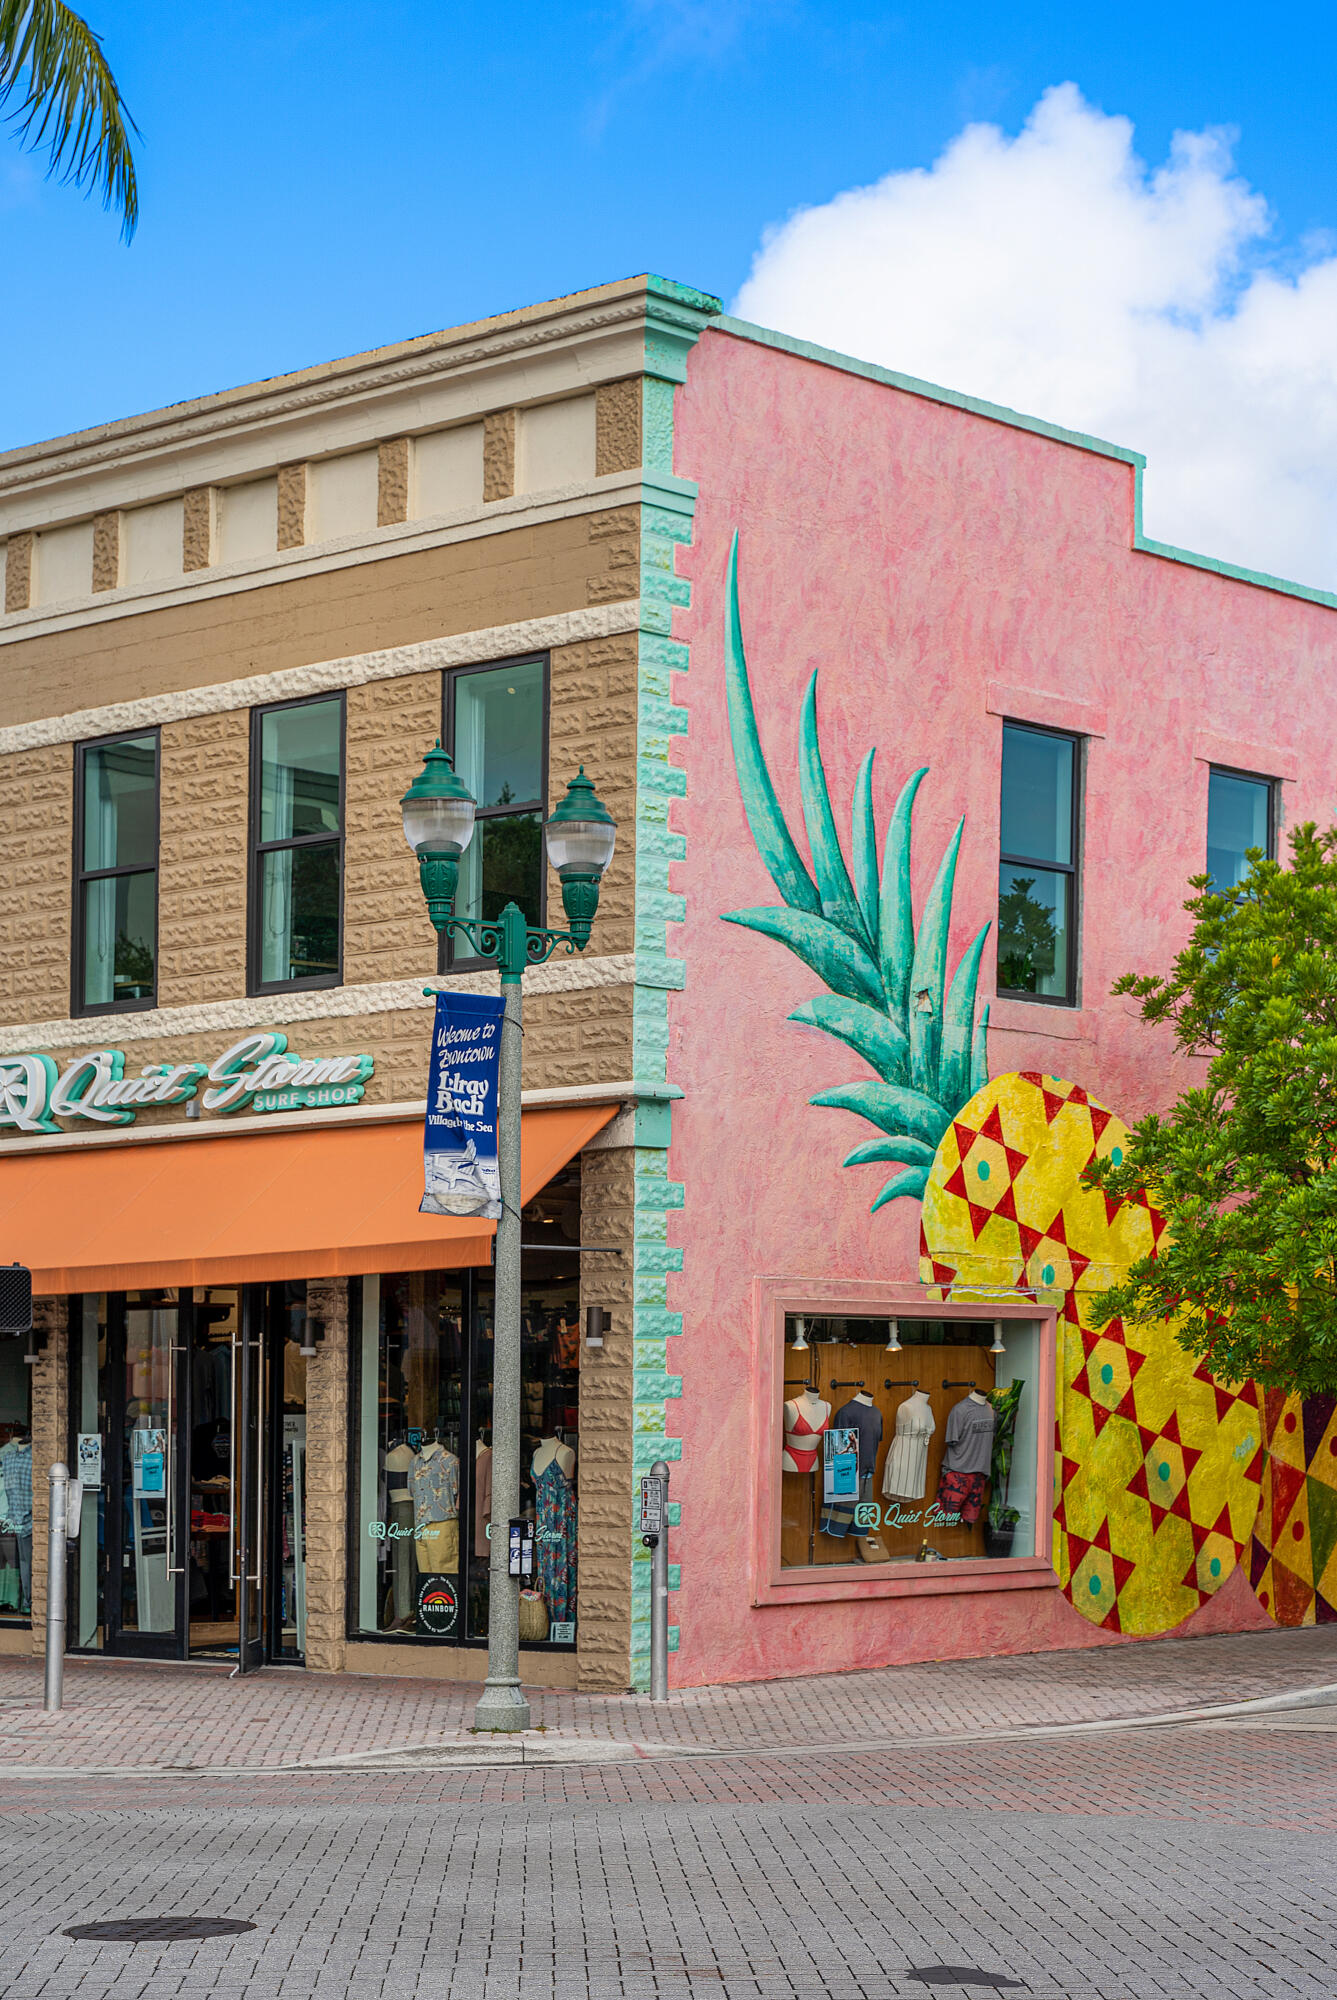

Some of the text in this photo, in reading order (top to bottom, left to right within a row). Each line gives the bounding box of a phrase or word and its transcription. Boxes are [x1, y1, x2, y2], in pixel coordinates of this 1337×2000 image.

[437, 1022, 496, 1047] Wlcome to
[439, 1046, 494, 1069] Dwntown
[50, 1050, 203, 1122] Quiet
[202, 1033, 366, 1110] Storm
[255, 1086, 358, 1109] SURF SHOP
[434, 1089, 485, 1116] Bach
[476, 1120, 493, 1133] Sea
[884, 1502, 923, 1529] Quiet
[923, 1502, 961, 1527] Storm
[387, 1522, 414, 1540] Quiet
[535, 1525, 562, 1541] Storm
[422, 1604, 455, 1613] RAINBOW
